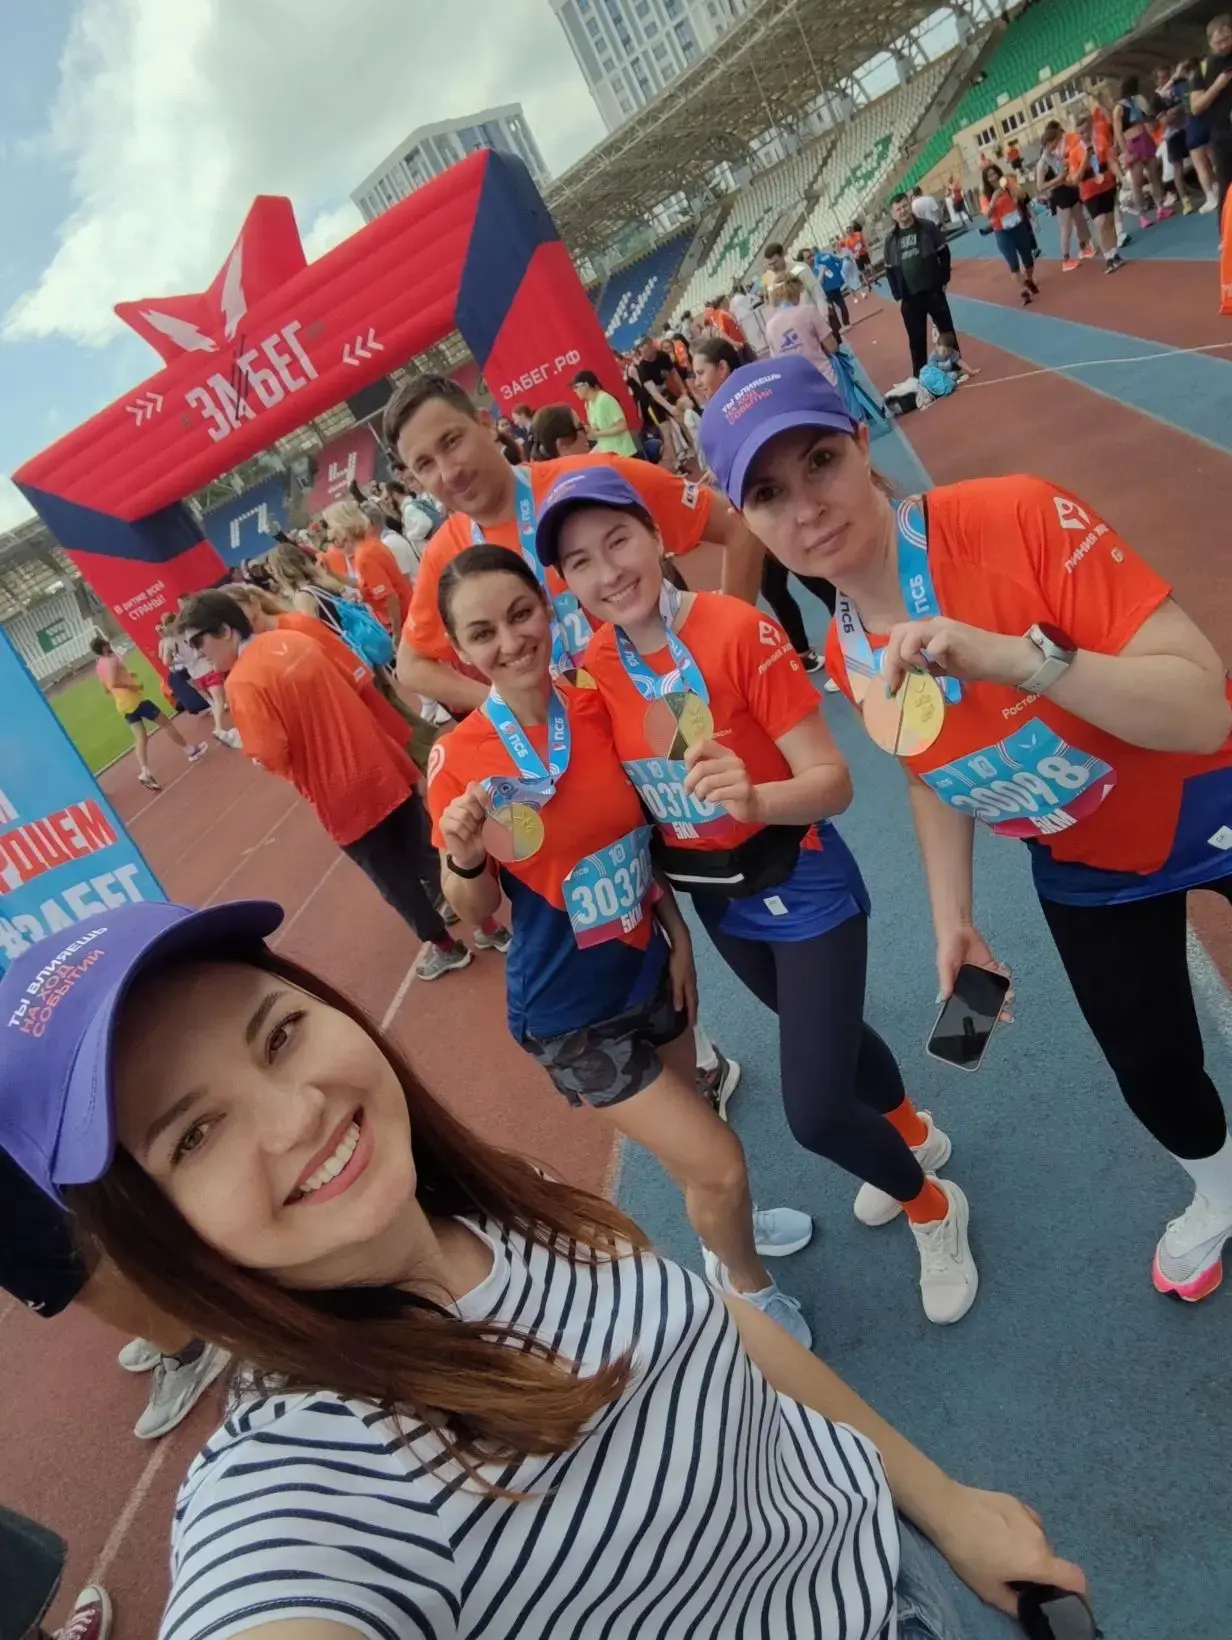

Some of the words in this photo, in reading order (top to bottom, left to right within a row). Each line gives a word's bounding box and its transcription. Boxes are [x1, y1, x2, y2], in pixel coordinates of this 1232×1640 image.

[184, 320, 319, 442] ЗАБЕГ
[500, 350, 580, 400] ЗАБЕГ.РФ
[1064, 532, 1098, 574] ЛИНИЯ
[909, 574, 930, 614] ПСБ
[840, 601, 855, 634] ПСБ
[509, 734, 529, 758] ПСБ
[554, 717, 564, 741] ПСБ
[8, 998, 30, 1027] ТЫ
[26, 927, 108, 995] ВЛИЯЕШЬ
[20, 1006, 41, 1034] НА
[36, 964, 74, 1000] ХОД
[32, 948, 105, 1037] СОБЫТИЙ
